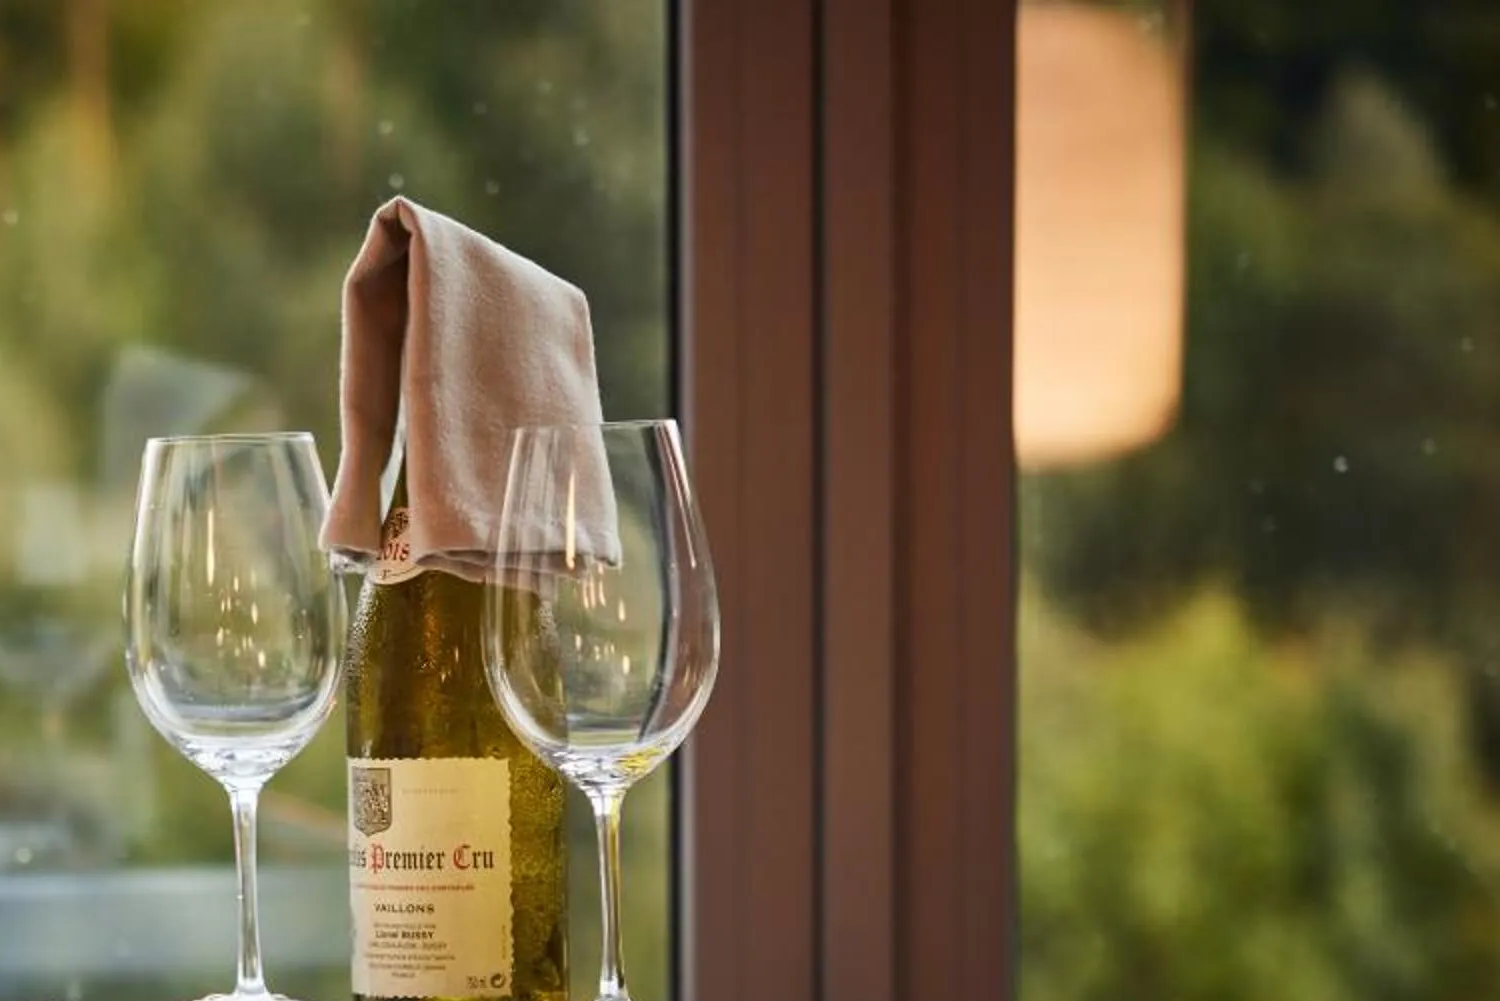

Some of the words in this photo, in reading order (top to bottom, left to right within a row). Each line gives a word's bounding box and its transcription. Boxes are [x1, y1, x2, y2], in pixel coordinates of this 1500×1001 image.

[370, 842, 446, 874] Premier
[452, 843, 495, 871] Cru
[373, 903, 436, 915] VAILLONS
